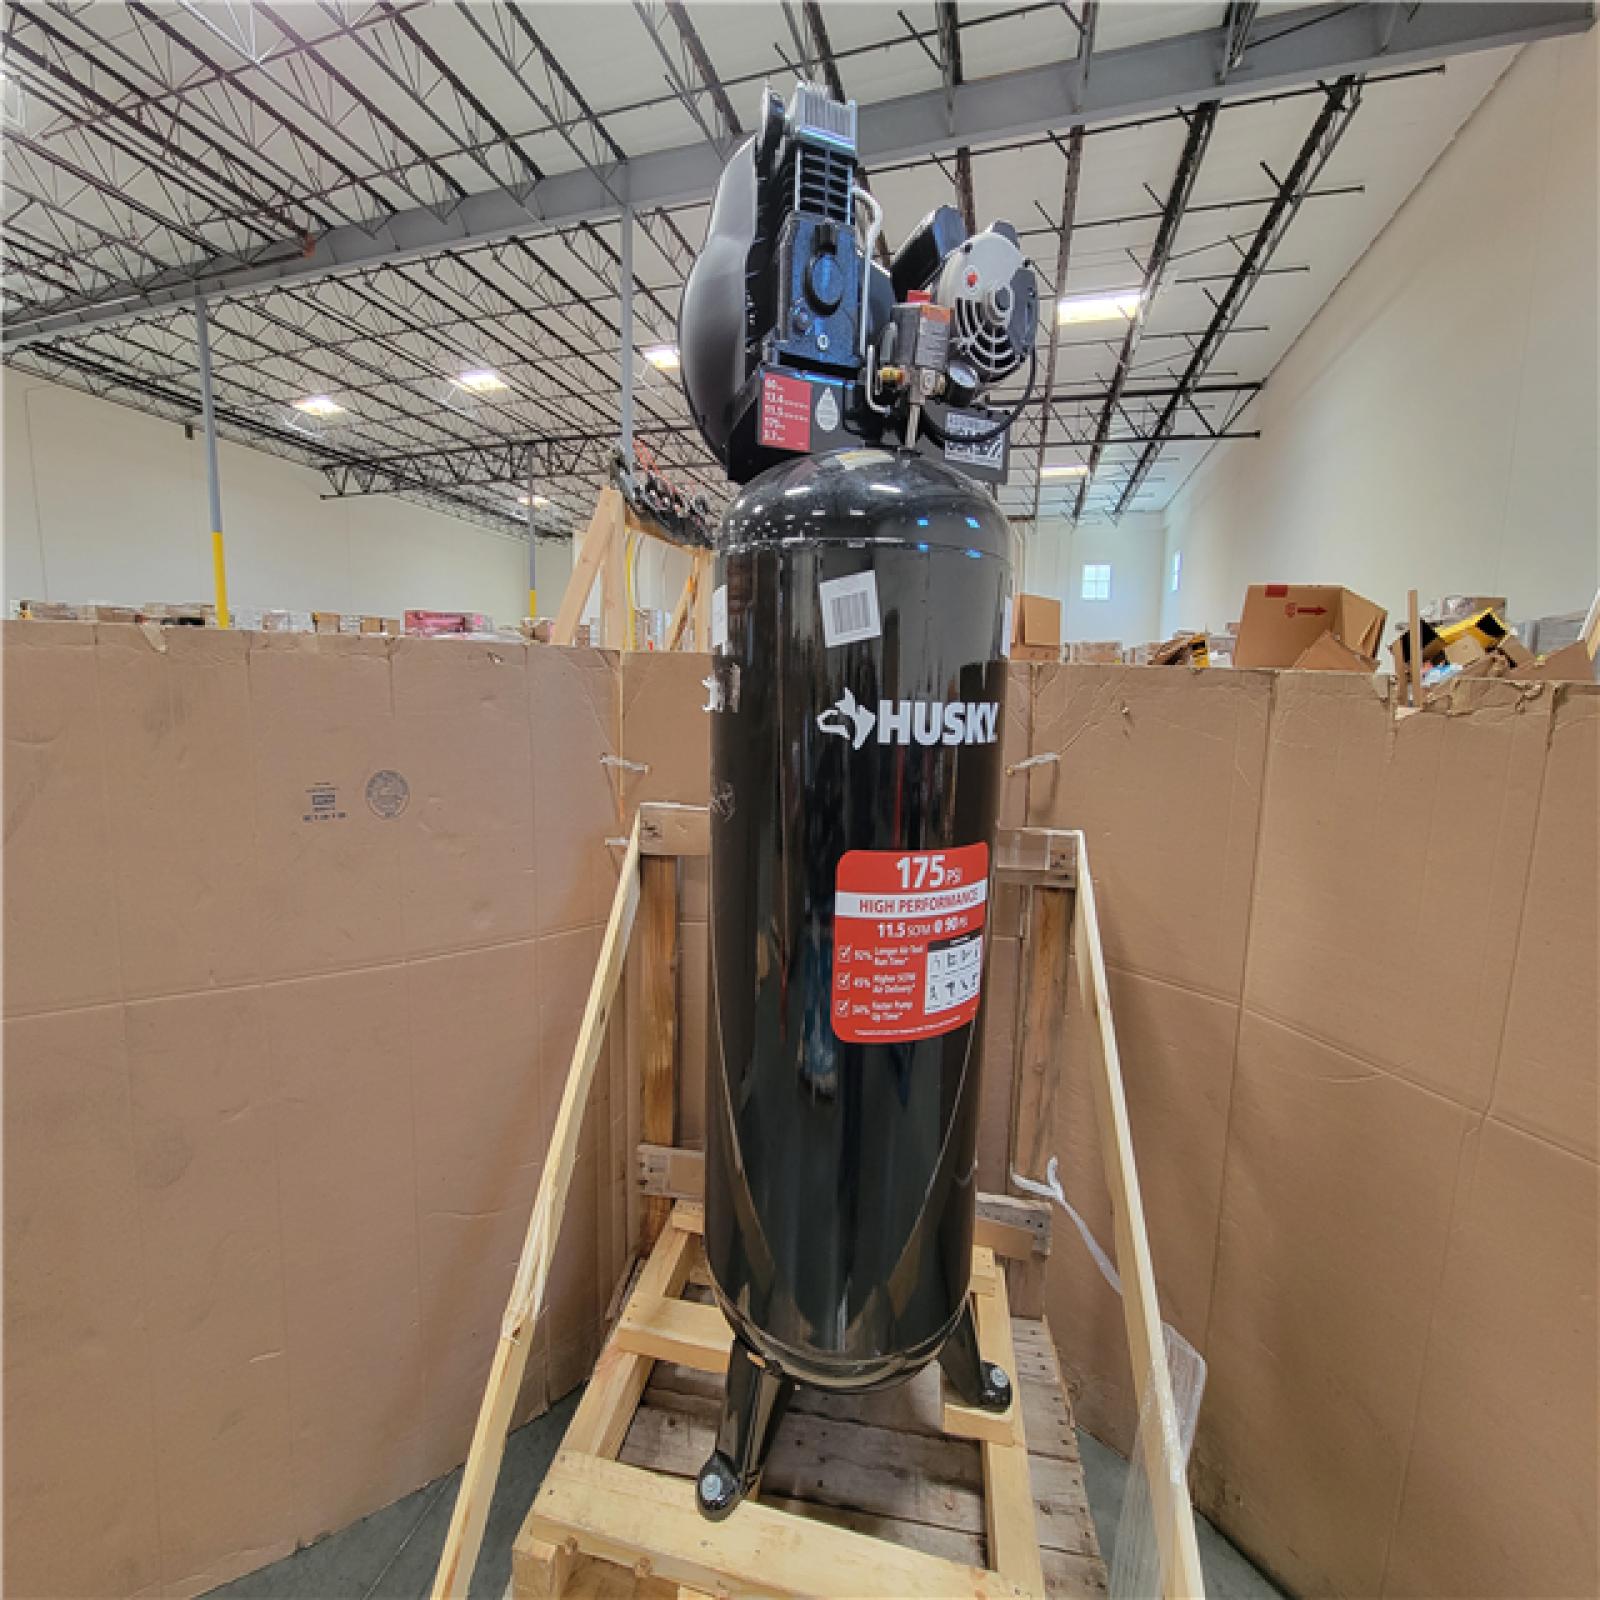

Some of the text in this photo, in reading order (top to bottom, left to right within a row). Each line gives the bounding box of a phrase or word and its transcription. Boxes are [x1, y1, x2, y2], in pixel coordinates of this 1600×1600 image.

[878, 699, 999, 746] HUSKY
[896, 855, 963, 888] 175 PSI
[859, 888, 979, 913] HIGH PERFORMANCE
[877, 922, 905, 938] 11.5
[908, 924, 931, 937] SCFM
